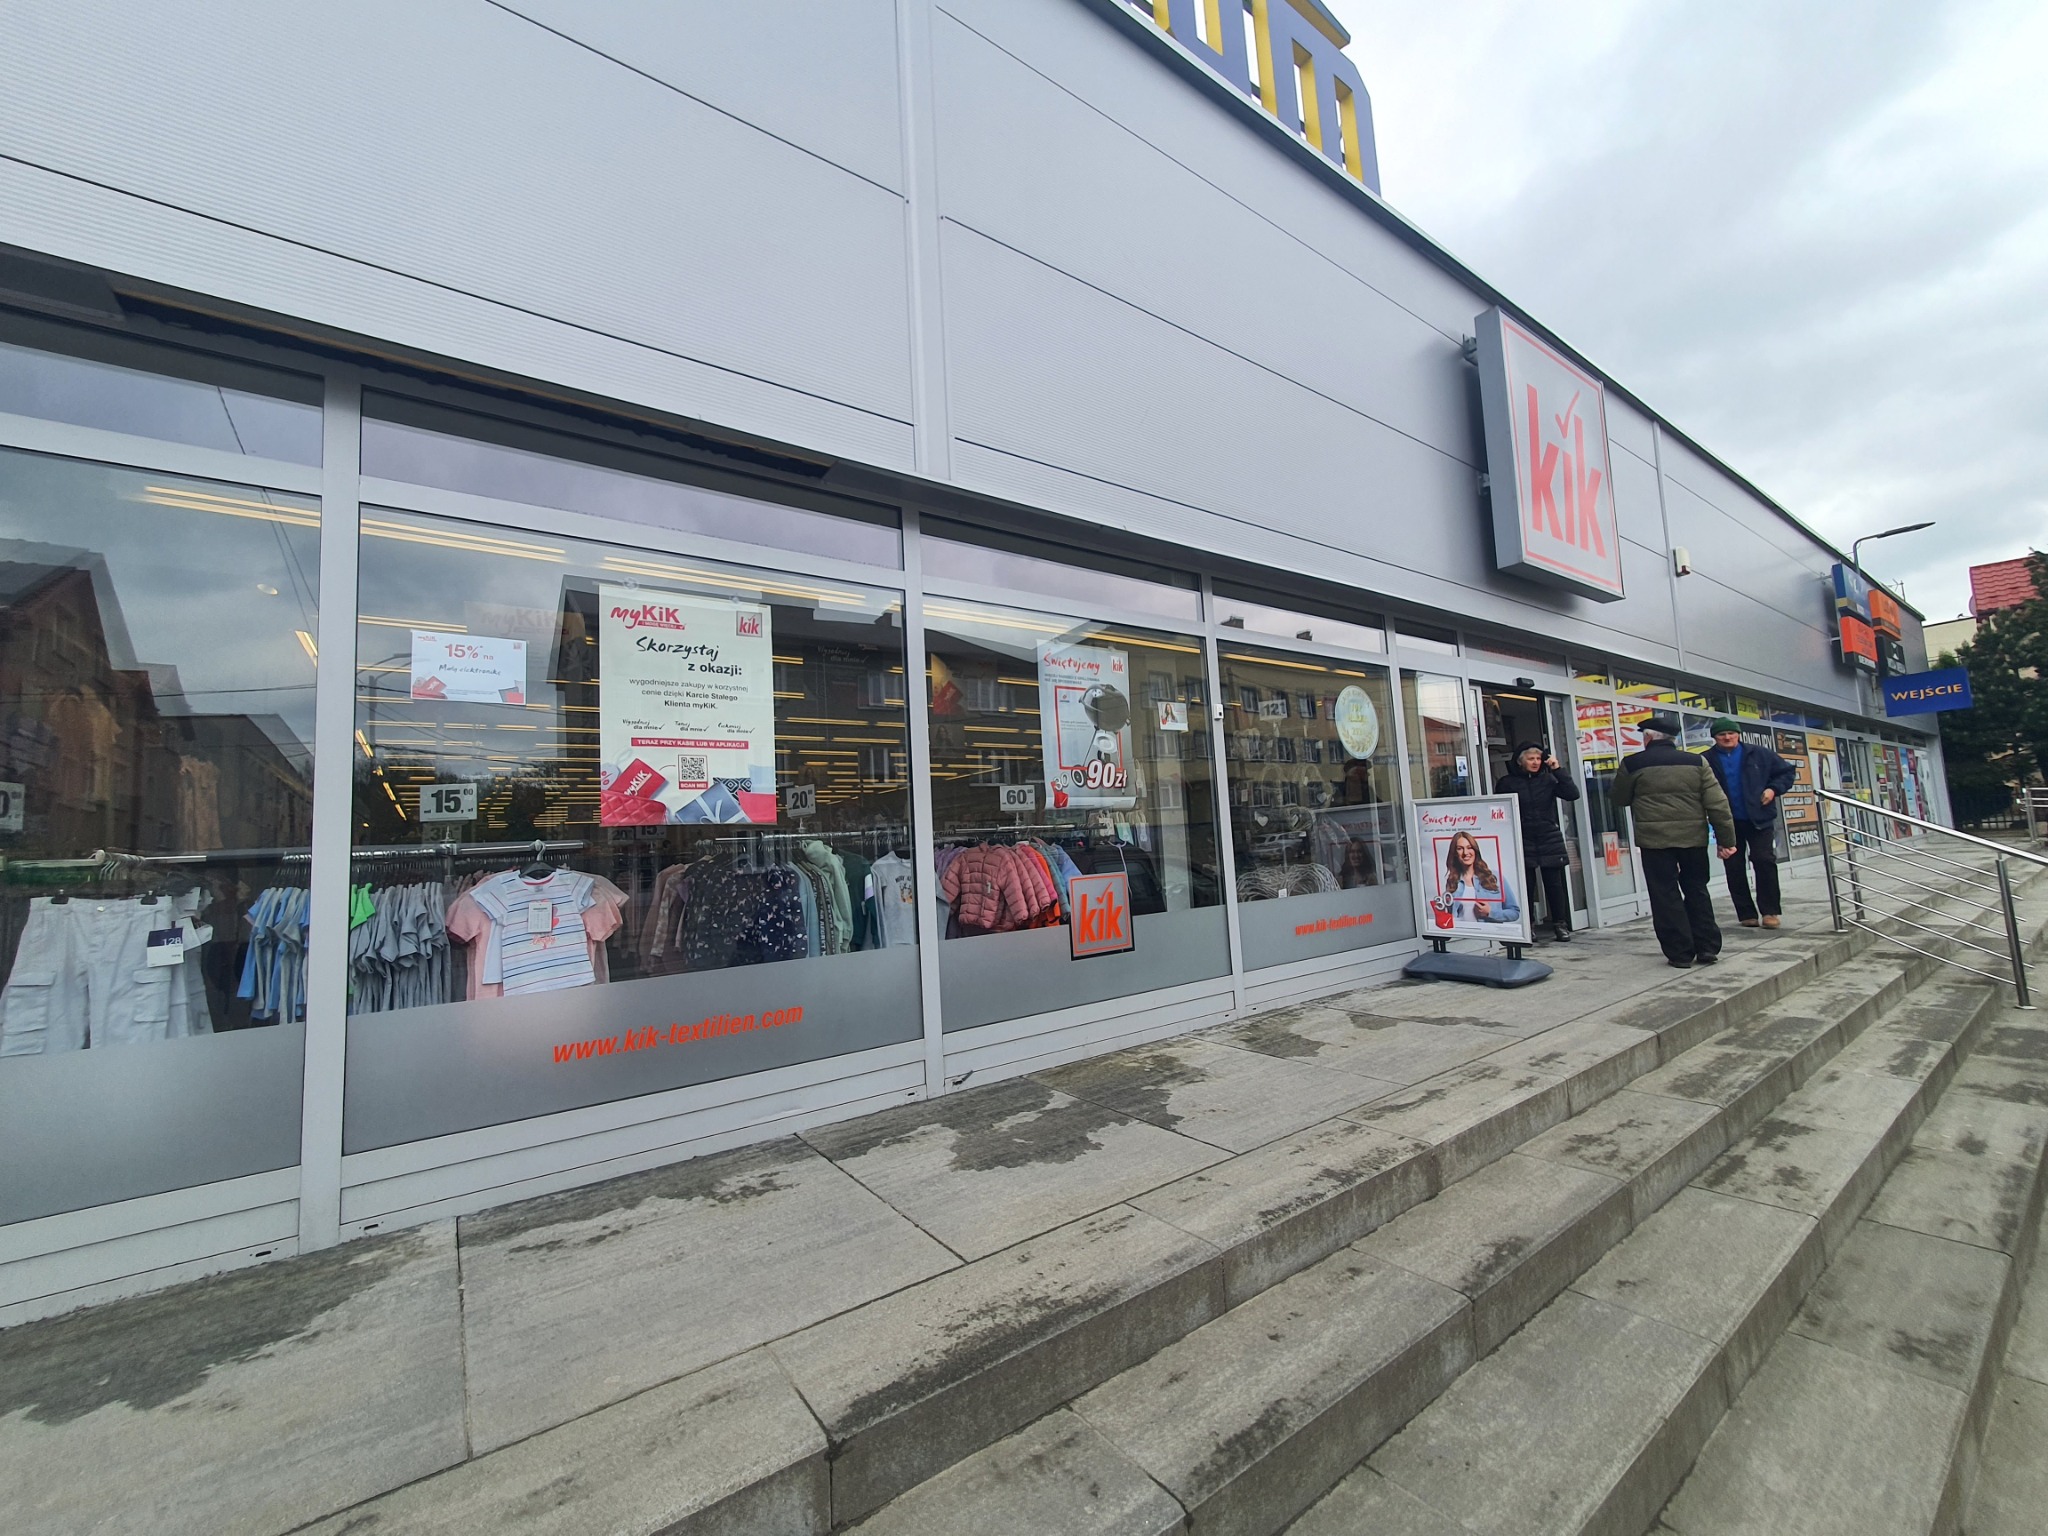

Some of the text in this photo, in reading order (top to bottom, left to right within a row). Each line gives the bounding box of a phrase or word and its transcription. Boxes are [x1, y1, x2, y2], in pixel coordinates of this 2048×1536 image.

[1526, 383, 1607, 560] kik
[610, 605, 681, 629] myKiK
[739, 615, 759, 635] kik
[635, 636, 719, 662] Skorzystaj
[687, 663, 743, 676] z okazji:
[1043, 648, 1100, 675] Świętujemy
[1112, 658, 1124, 673] kik
[629, 678, 680, 688] wygodniejsze
[680, 680, 706, 690] zakupy
[714, 683, 749, 692] korzystnej
[1890, 683, 1964, 701] WEJŚCIE
[664, 700, 691, 708] Klienta
[685, 691, 710, 699] Karcie
[1422, 810, 1478, 826] Świętujemy
[1491, 808, 1504, 820] kik
[1789, 830, 1820, 847] SERWIS
[1605, 841, 1619, 867] kik
[1434, 891, 1454, 911] 30
[1079, 883, 1124, 945] kik
[553, 1005, 804, 1064] www.kik-textilien.com
